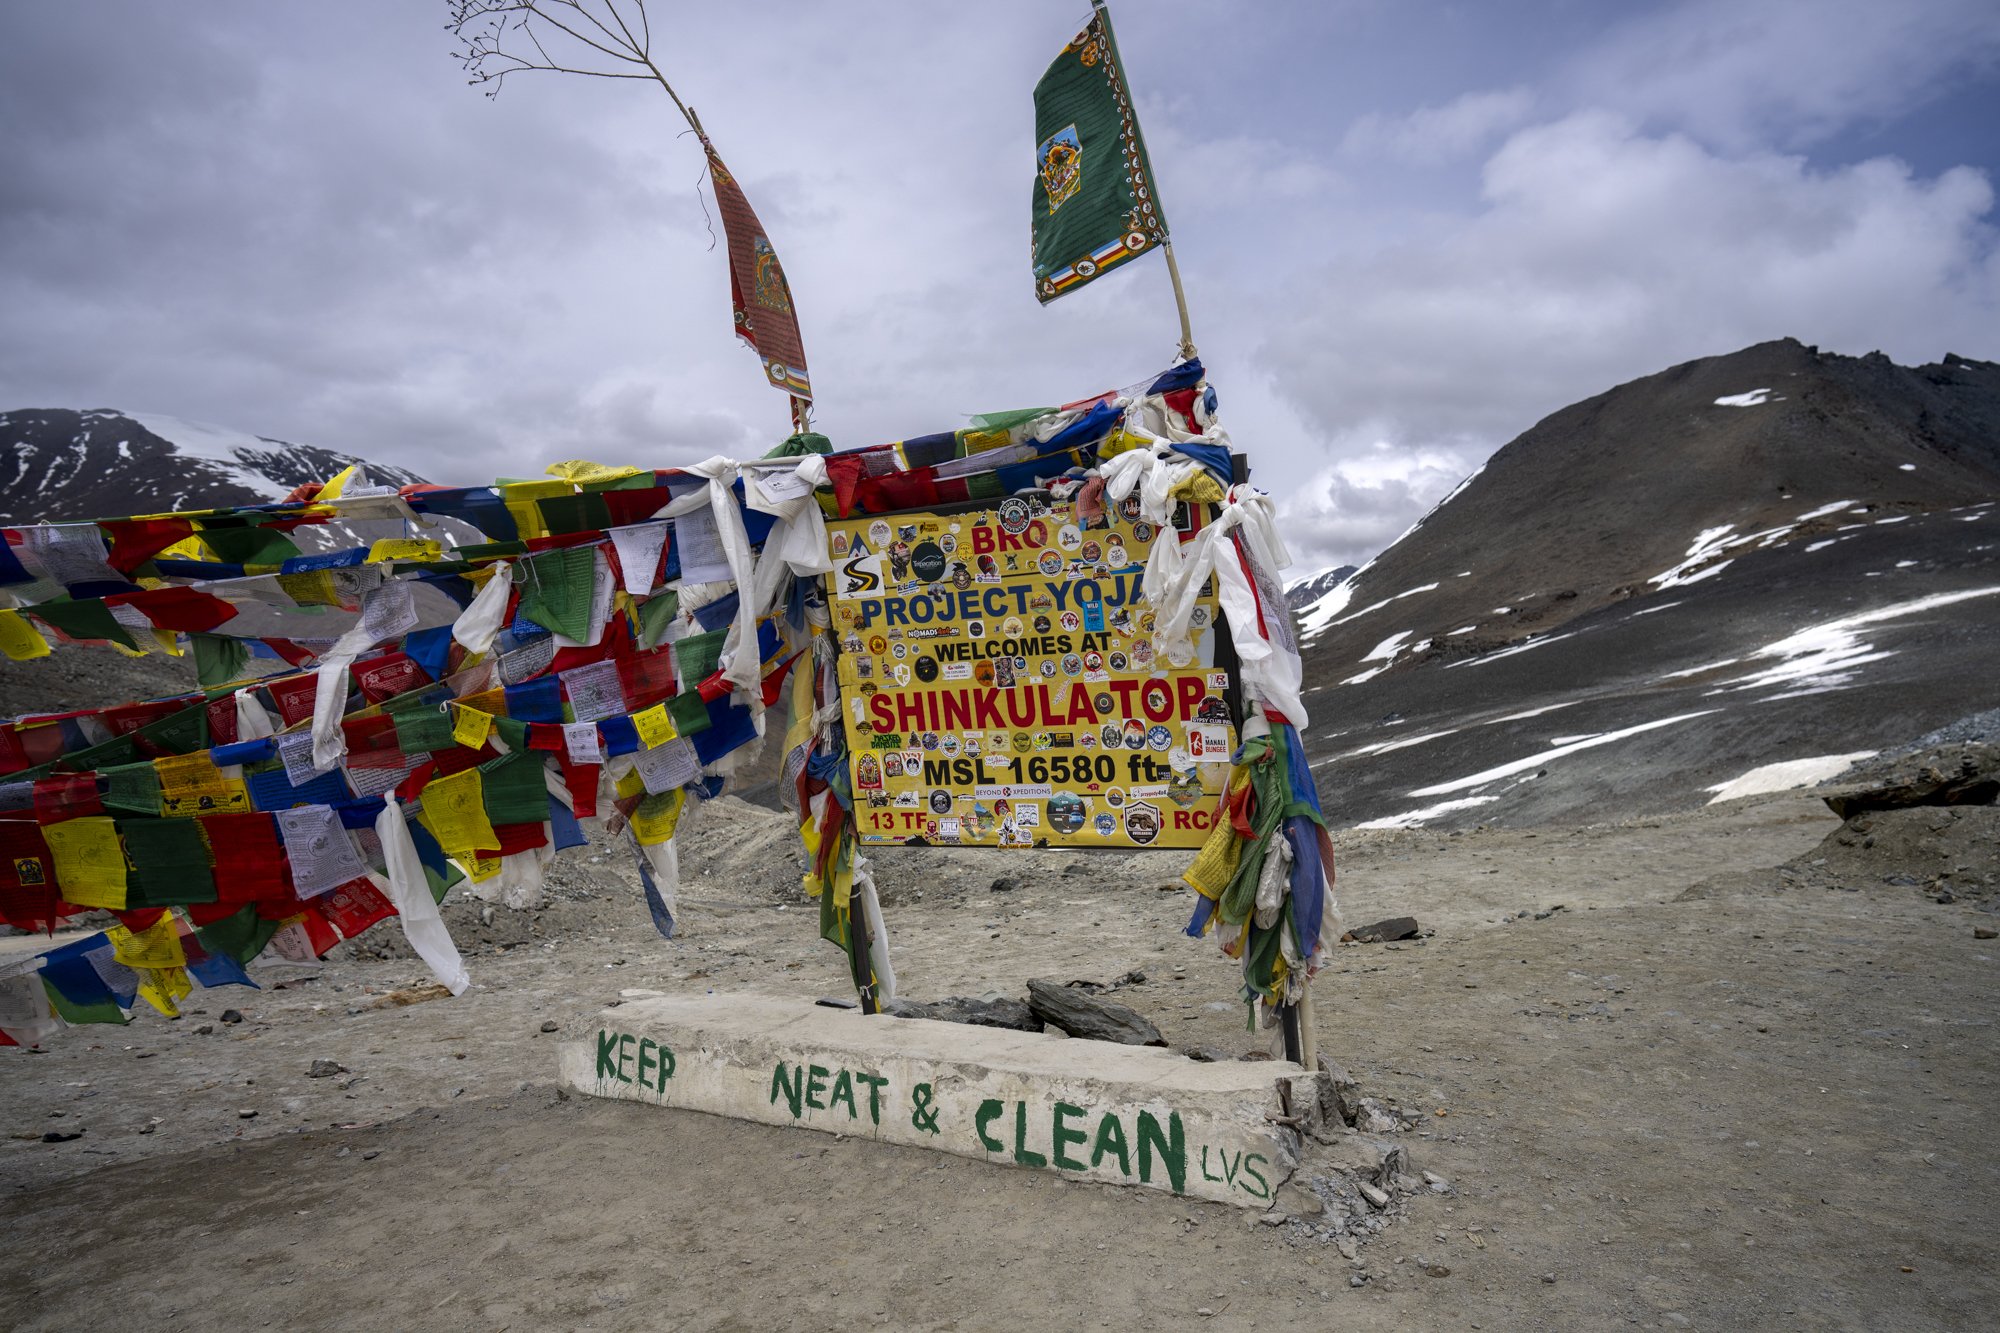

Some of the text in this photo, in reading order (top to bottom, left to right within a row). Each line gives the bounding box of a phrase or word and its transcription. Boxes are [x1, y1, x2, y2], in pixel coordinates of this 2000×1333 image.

[1001, 500, 1017, 515] MOUNT
[971, 520, 1047, 555] BRO
[1003, 519, 1030, 535] ADVENTURE
[861, 585, 1032, 628] PROJECT
[934, 632, 1111, 662] WELCOMES AT
[870, 676, 1206, 733] SHINKULA TOP
[924, 758, 996, 786] MSL
[1007, 754, 1116, 785] 16580
[1012, 787, 1051, 795] XPEDITIONS
[870, 812, 894, 830] 13
[901, 812, 927, 830] TF
[596, 1029, 676, 1094] KEEP
[770, 1061, 889, 1126] NEAT
[912, 1082, 940, 1135] &
[975, 1099, 1187, 1195] CLEAN
